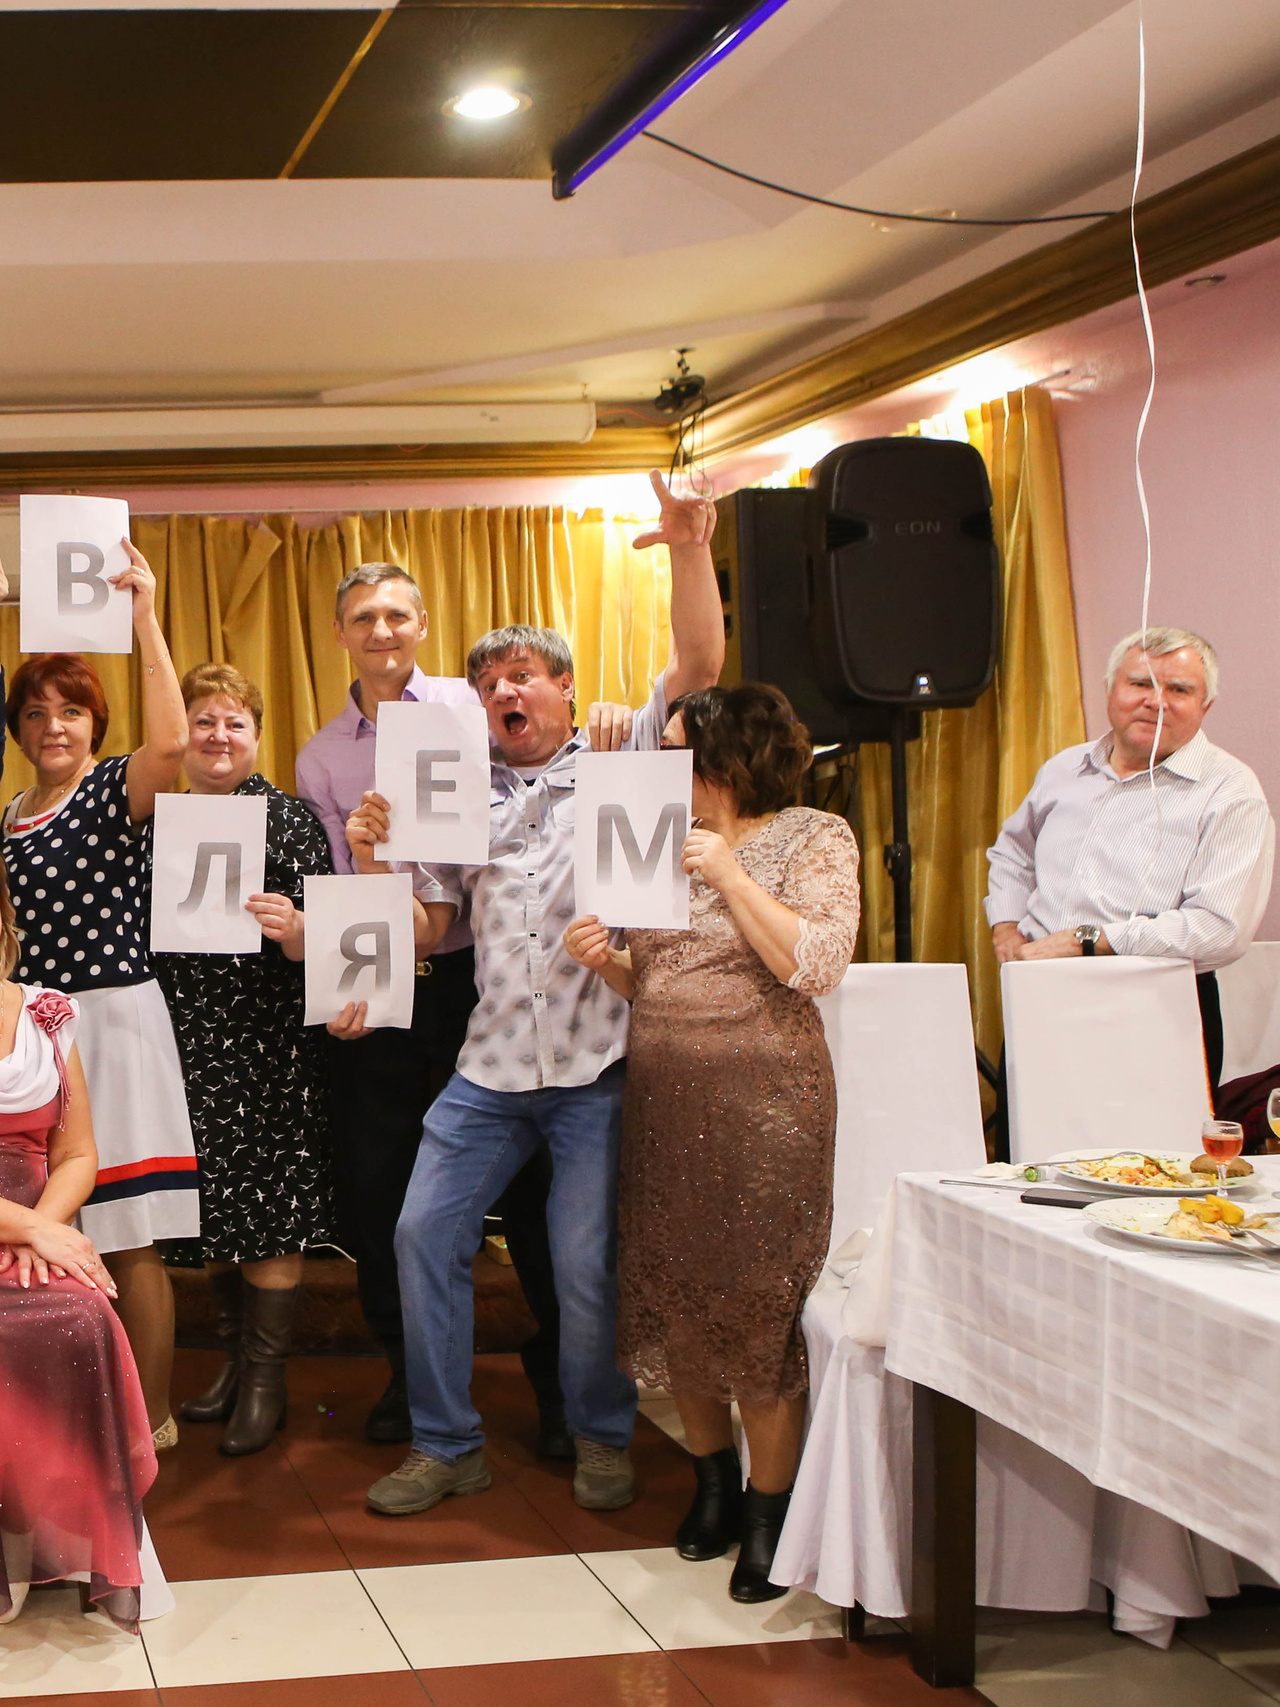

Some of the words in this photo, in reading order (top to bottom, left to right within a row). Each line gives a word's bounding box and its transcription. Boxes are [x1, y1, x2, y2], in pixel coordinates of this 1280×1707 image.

[894, 521, 940, 536] EON
[56, 542, 110, 616] В
[415, 749, 461, 824] Е
[176, 842, 242, 917] Л
[596, 803, 686, 890] М
[336, 921, 392, 993] Я
